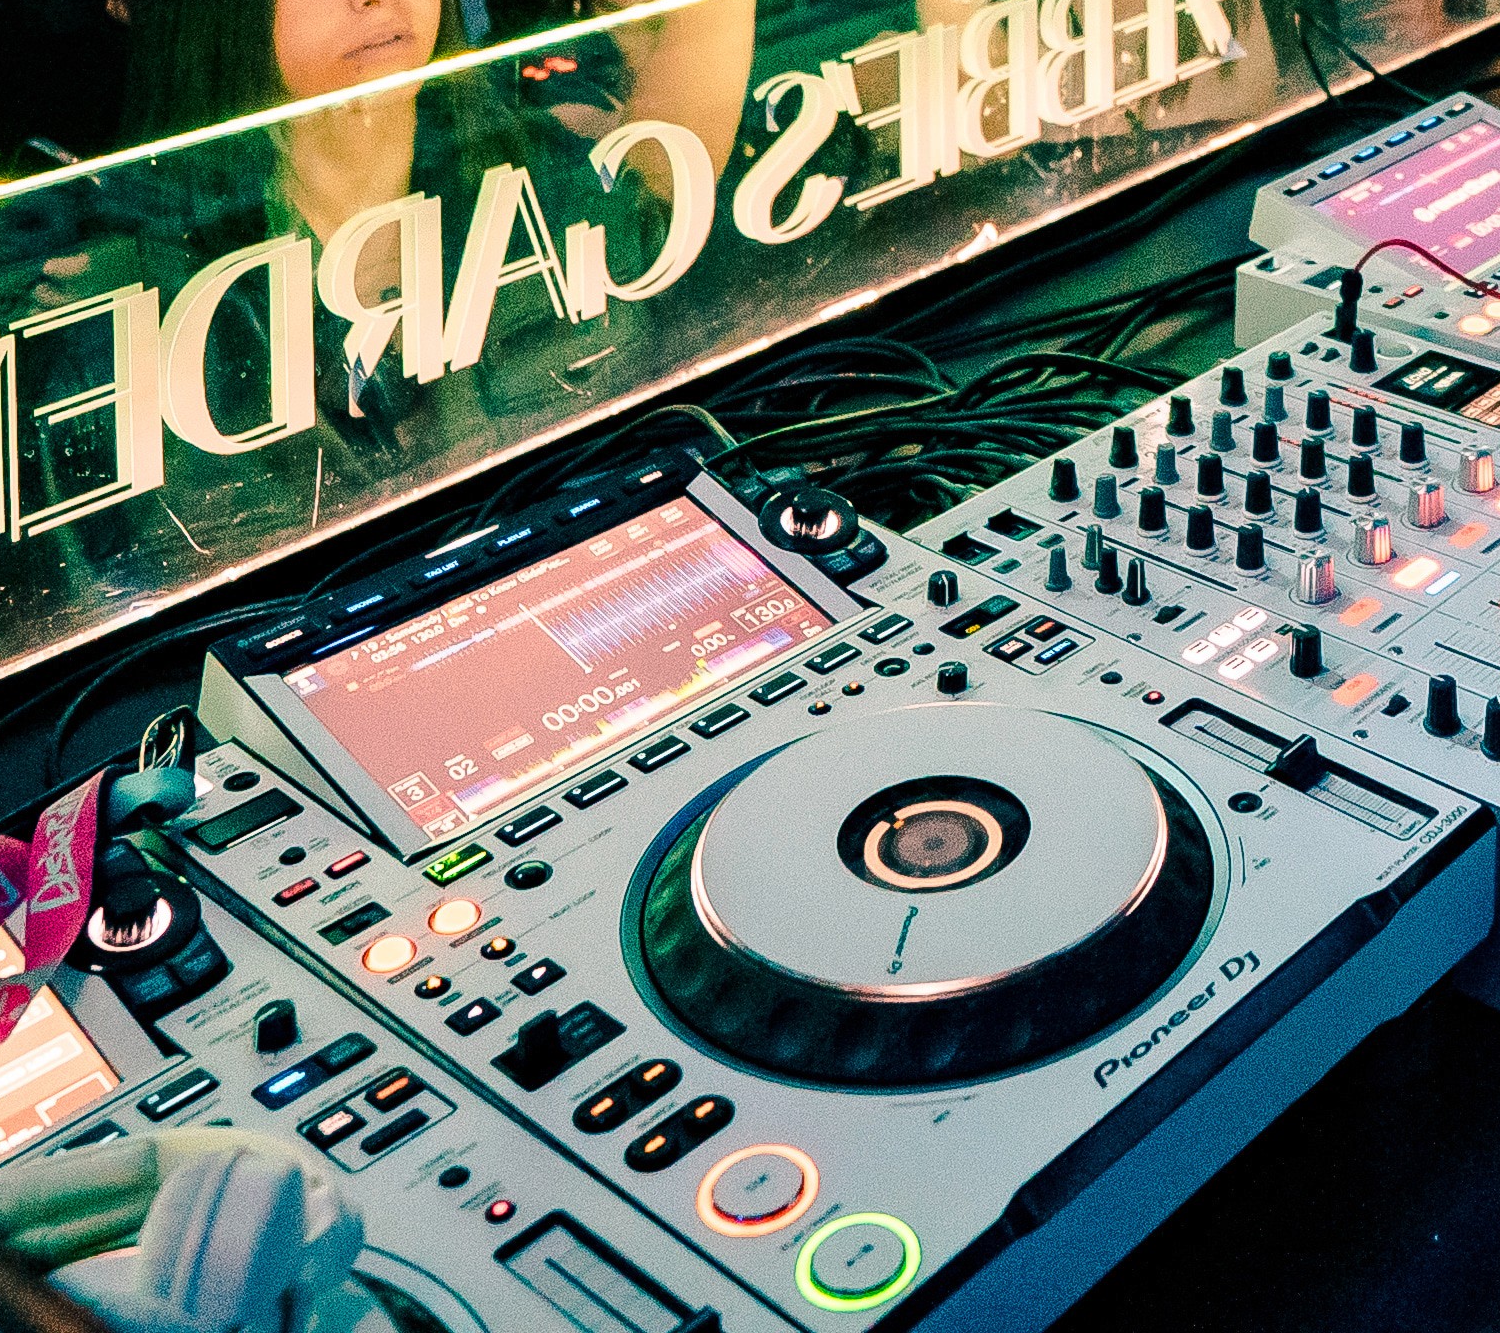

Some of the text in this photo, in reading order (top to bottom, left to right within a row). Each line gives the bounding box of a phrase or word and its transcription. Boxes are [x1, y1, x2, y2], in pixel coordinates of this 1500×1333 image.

[384, 610, 443, 646] Somebody
[447, 756, 480, 783] 02
[1417, 800, 1468, 848] CDJ-3000
[1093, 978, 1218, 1089] Pioneer
